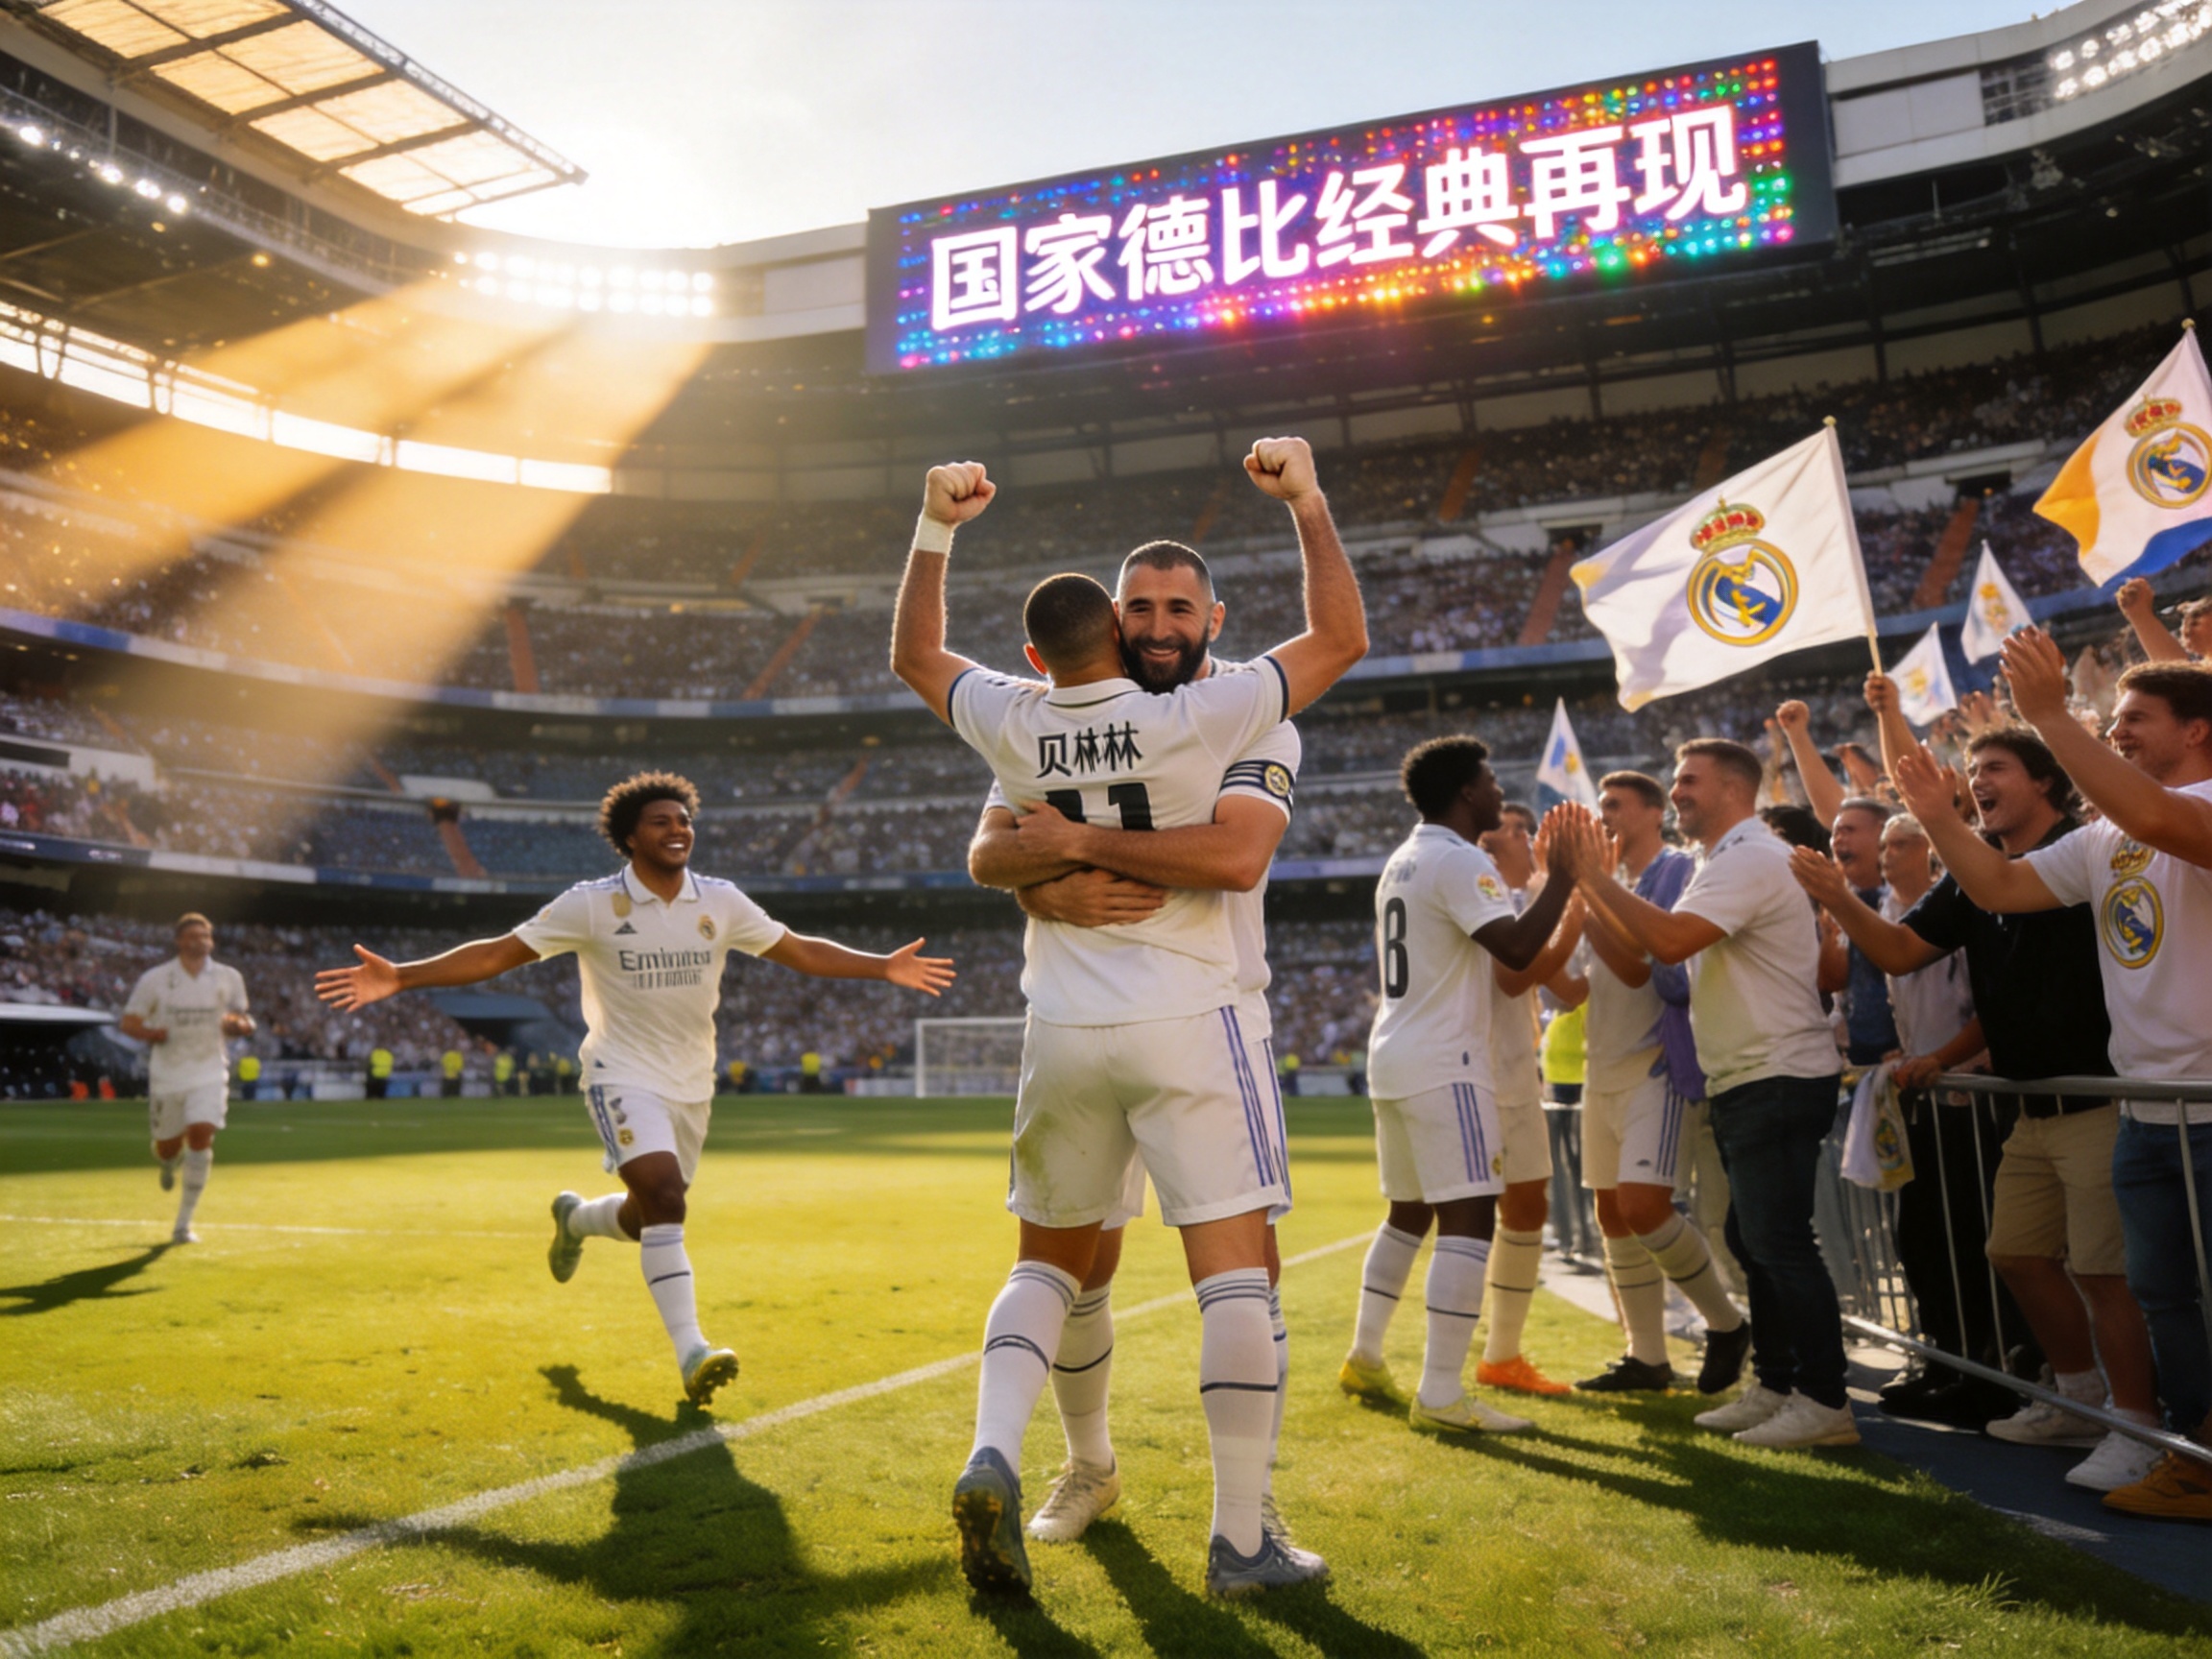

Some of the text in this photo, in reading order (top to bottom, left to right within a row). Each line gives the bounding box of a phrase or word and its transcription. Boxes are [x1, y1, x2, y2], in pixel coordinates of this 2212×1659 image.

[930, 104, 1747, 332] 国家德比经典再现
[1385, 897, 1408, 998] 8
